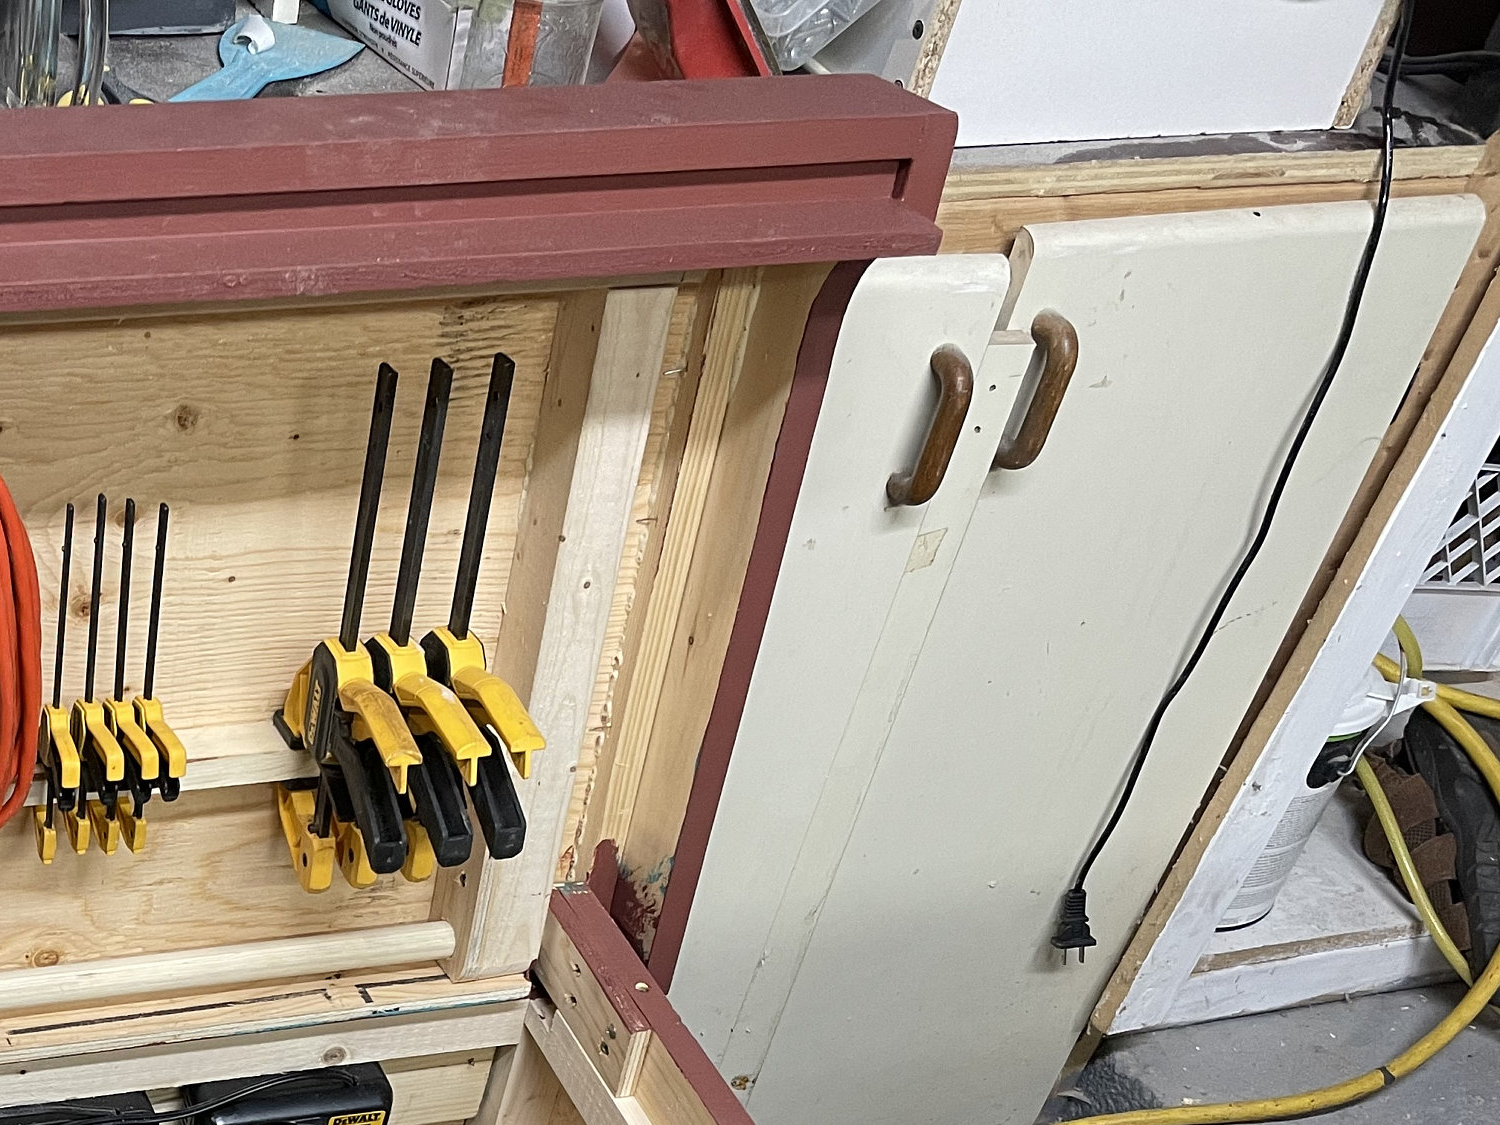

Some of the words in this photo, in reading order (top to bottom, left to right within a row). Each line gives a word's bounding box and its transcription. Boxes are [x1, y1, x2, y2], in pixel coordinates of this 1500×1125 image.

[353, 0, 380, 21] GANTS
[379, 11, 389, 29] de
[390, 16, 422, 47] VINYLE
